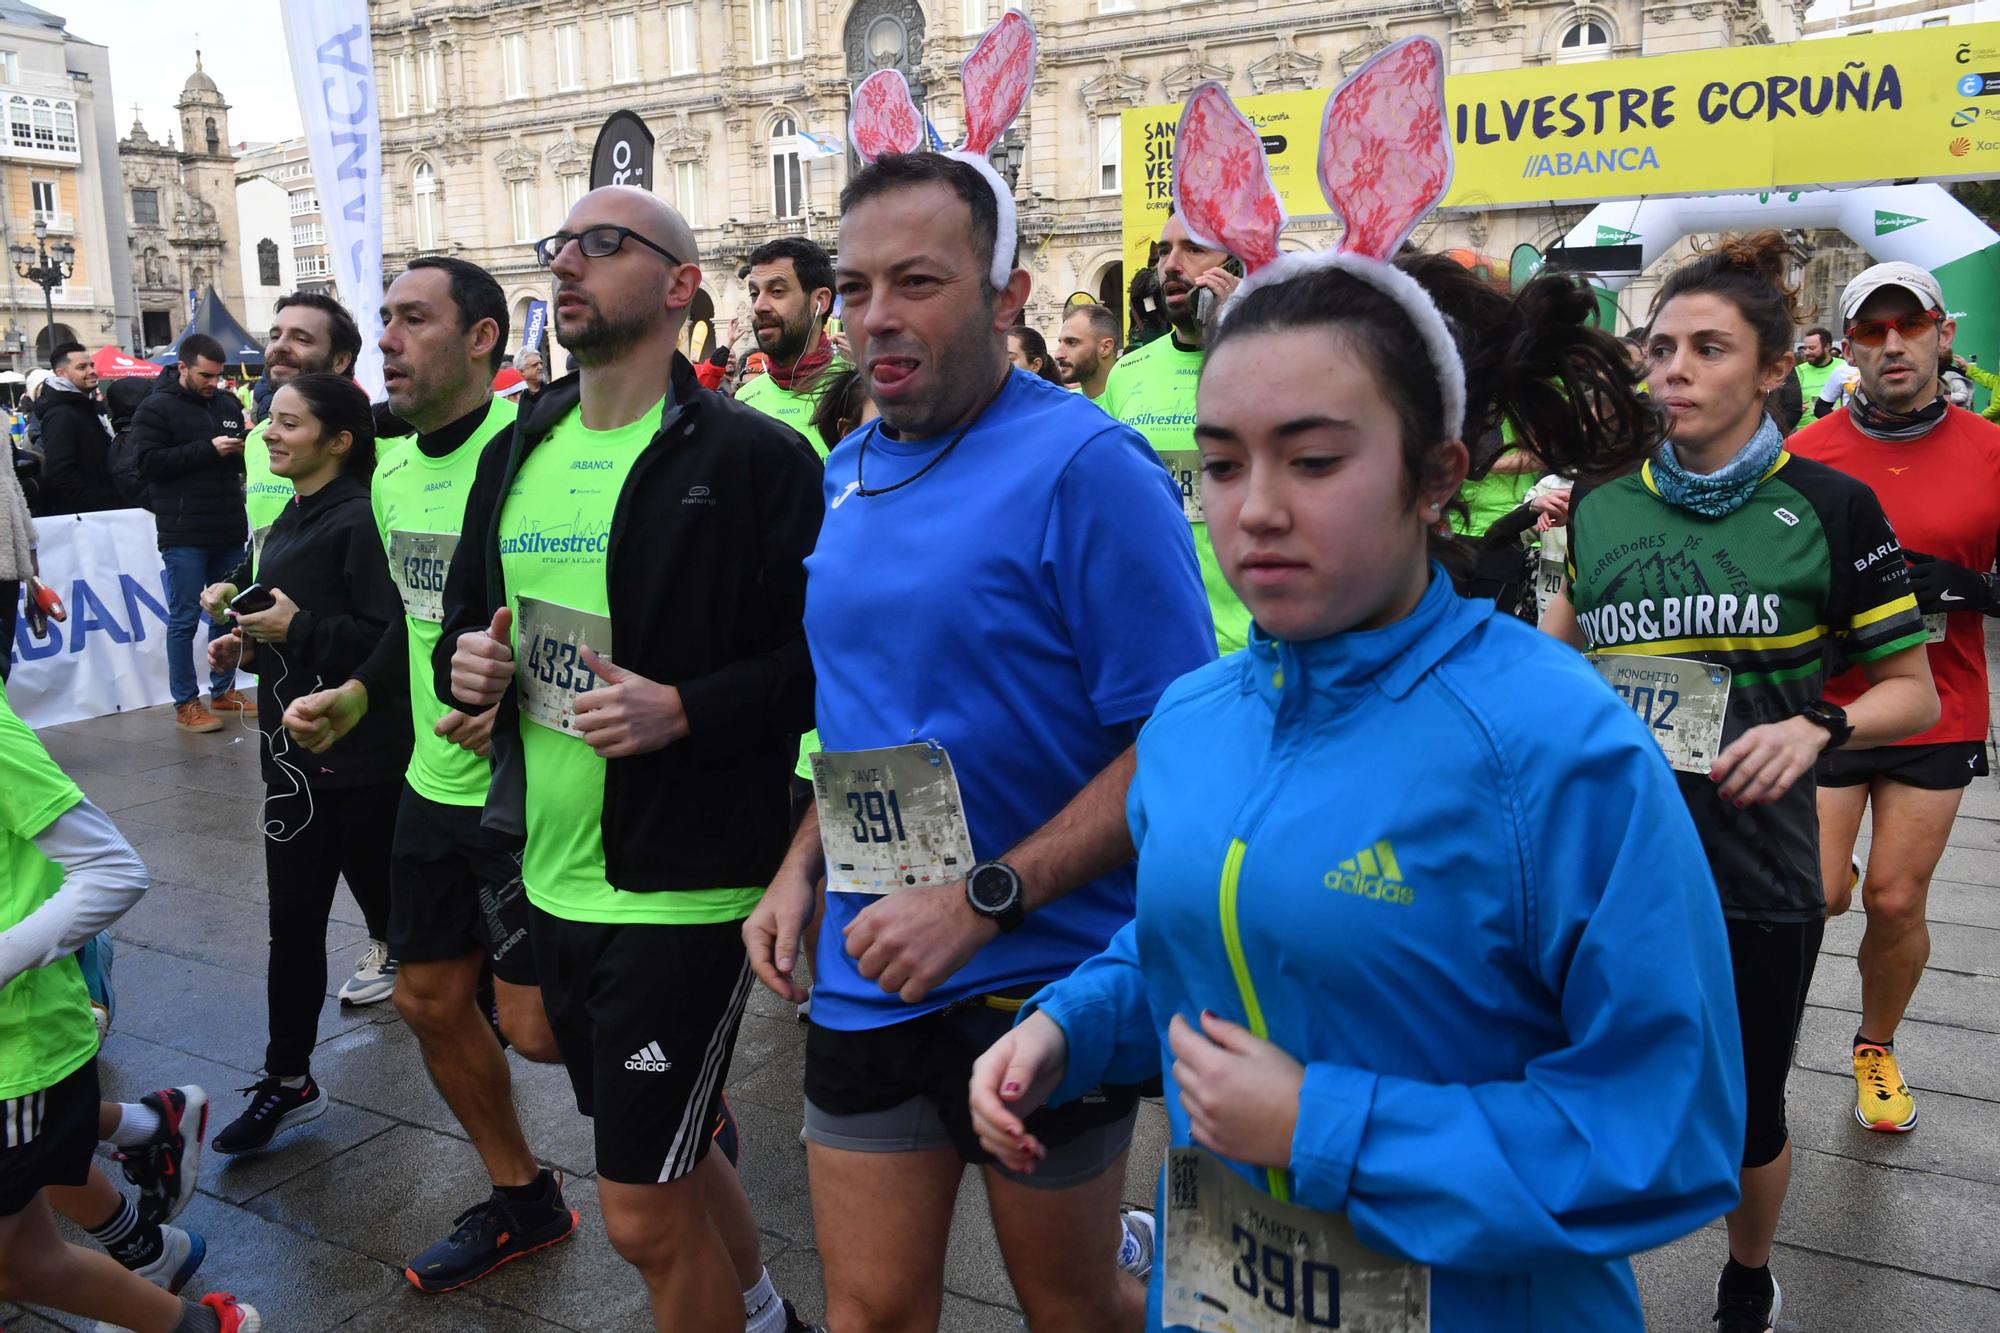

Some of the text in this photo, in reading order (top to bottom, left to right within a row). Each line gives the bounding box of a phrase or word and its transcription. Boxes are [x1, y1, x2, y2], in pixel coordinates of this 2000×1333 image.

[1698, 62, 1903, 124] CORUÑA
[1144, 121, 1176, 140] SAN
[404, 557, 443, 592] 1396
[1589, 532, 1751, 598] CORREDORES DE MONTES
[528, 634, 596, 693] 4335
[1617, 668, 1679, 684] MONCHITO
[846, 789, 906, 843] 391
[1323, 870, 1415, 907] adidas
[624, 1060, 672, 1072] adidas
[1250, 1211, 1311, 1246] MARTA
[1231, 1222, 1341, 1330] 390
